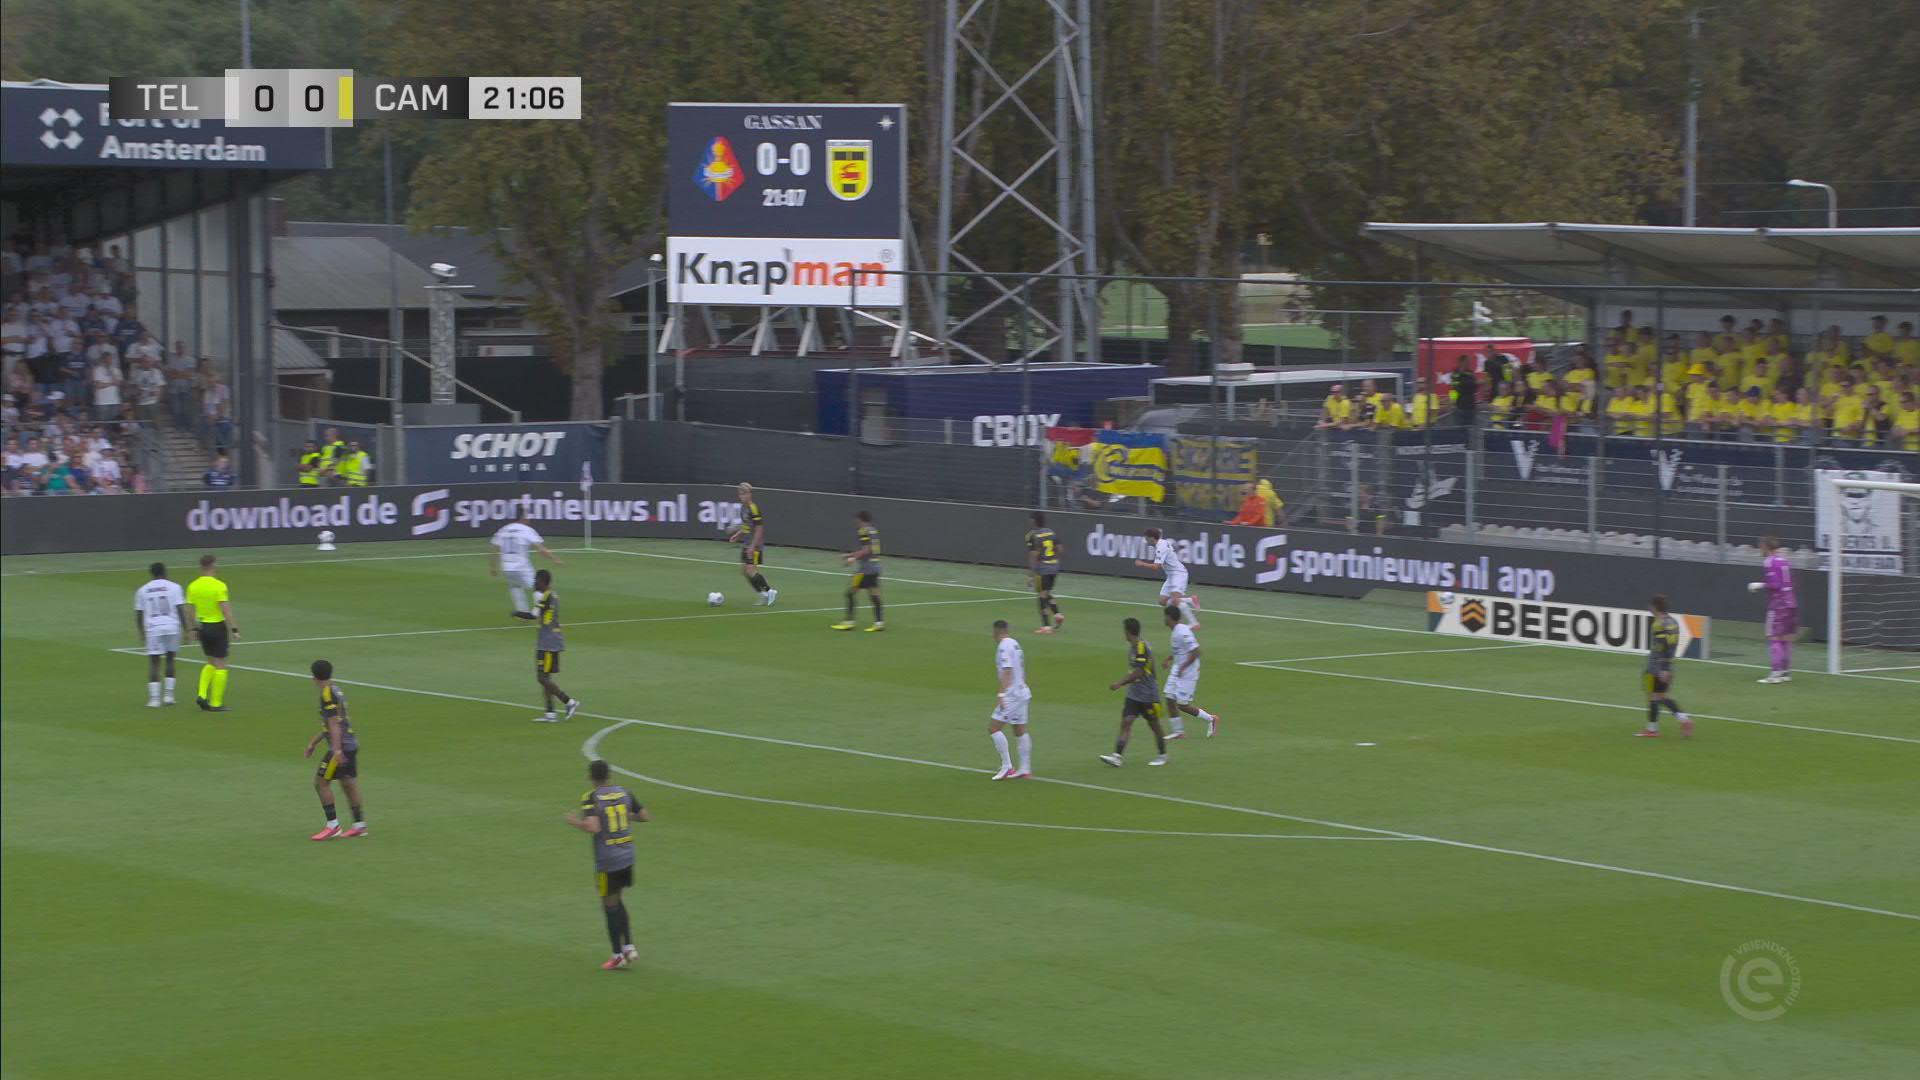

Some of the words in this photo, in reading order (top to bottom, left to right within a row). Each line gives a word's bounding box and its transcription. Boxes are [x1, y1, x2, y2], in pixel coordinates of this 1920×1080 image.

[743, 114, 823, 130] GASSAN
[99, 135, 266, 161] Amsterdam
[756, 142, 811, 176] 0-0
[761, 188, 806, 207] 21:07
[451, 432, 566, 460] SCHOT
[470, 462, 547, 473] INFRA
[186, 496, 350, 531] download
[356, 495, 398, 525] de
[454, 491, 688, 528] sportnieuws.nl
[1212, 534, 1245, 568] de
[1290, 547, 1489, 589] sportnieuws.nl
[1497, 565, 1555, 600] app
[1492, 601, 1652, 651] BEEQUI
[605, 804, 629, 833] 11
